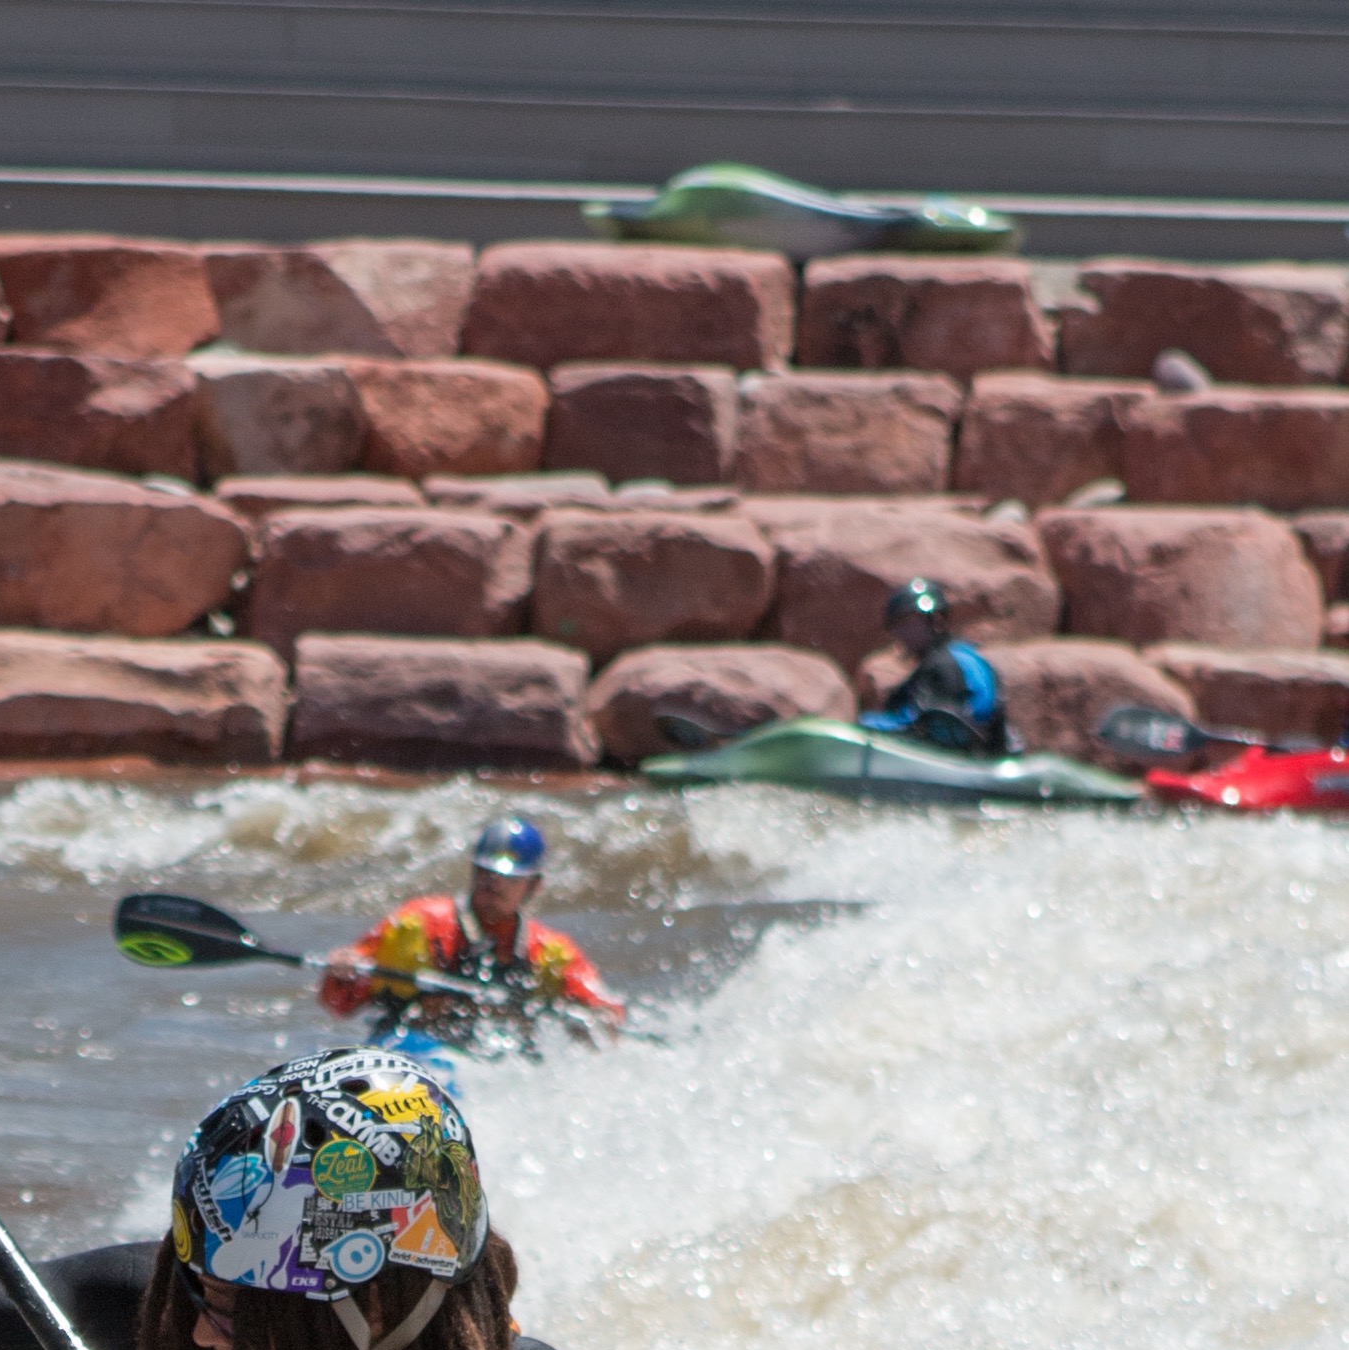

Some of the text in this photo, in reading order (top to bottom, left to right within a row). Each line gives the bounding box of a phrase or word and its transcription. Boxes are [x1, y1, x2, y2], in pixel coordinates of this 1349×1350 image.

[306, 1093, 400, 1167] THE CLYMB
[318, 1151, 367, 1185] Zeal
[344, 1194, 364, 1211] BE
[371, 1191, 412, 1209] KIND
